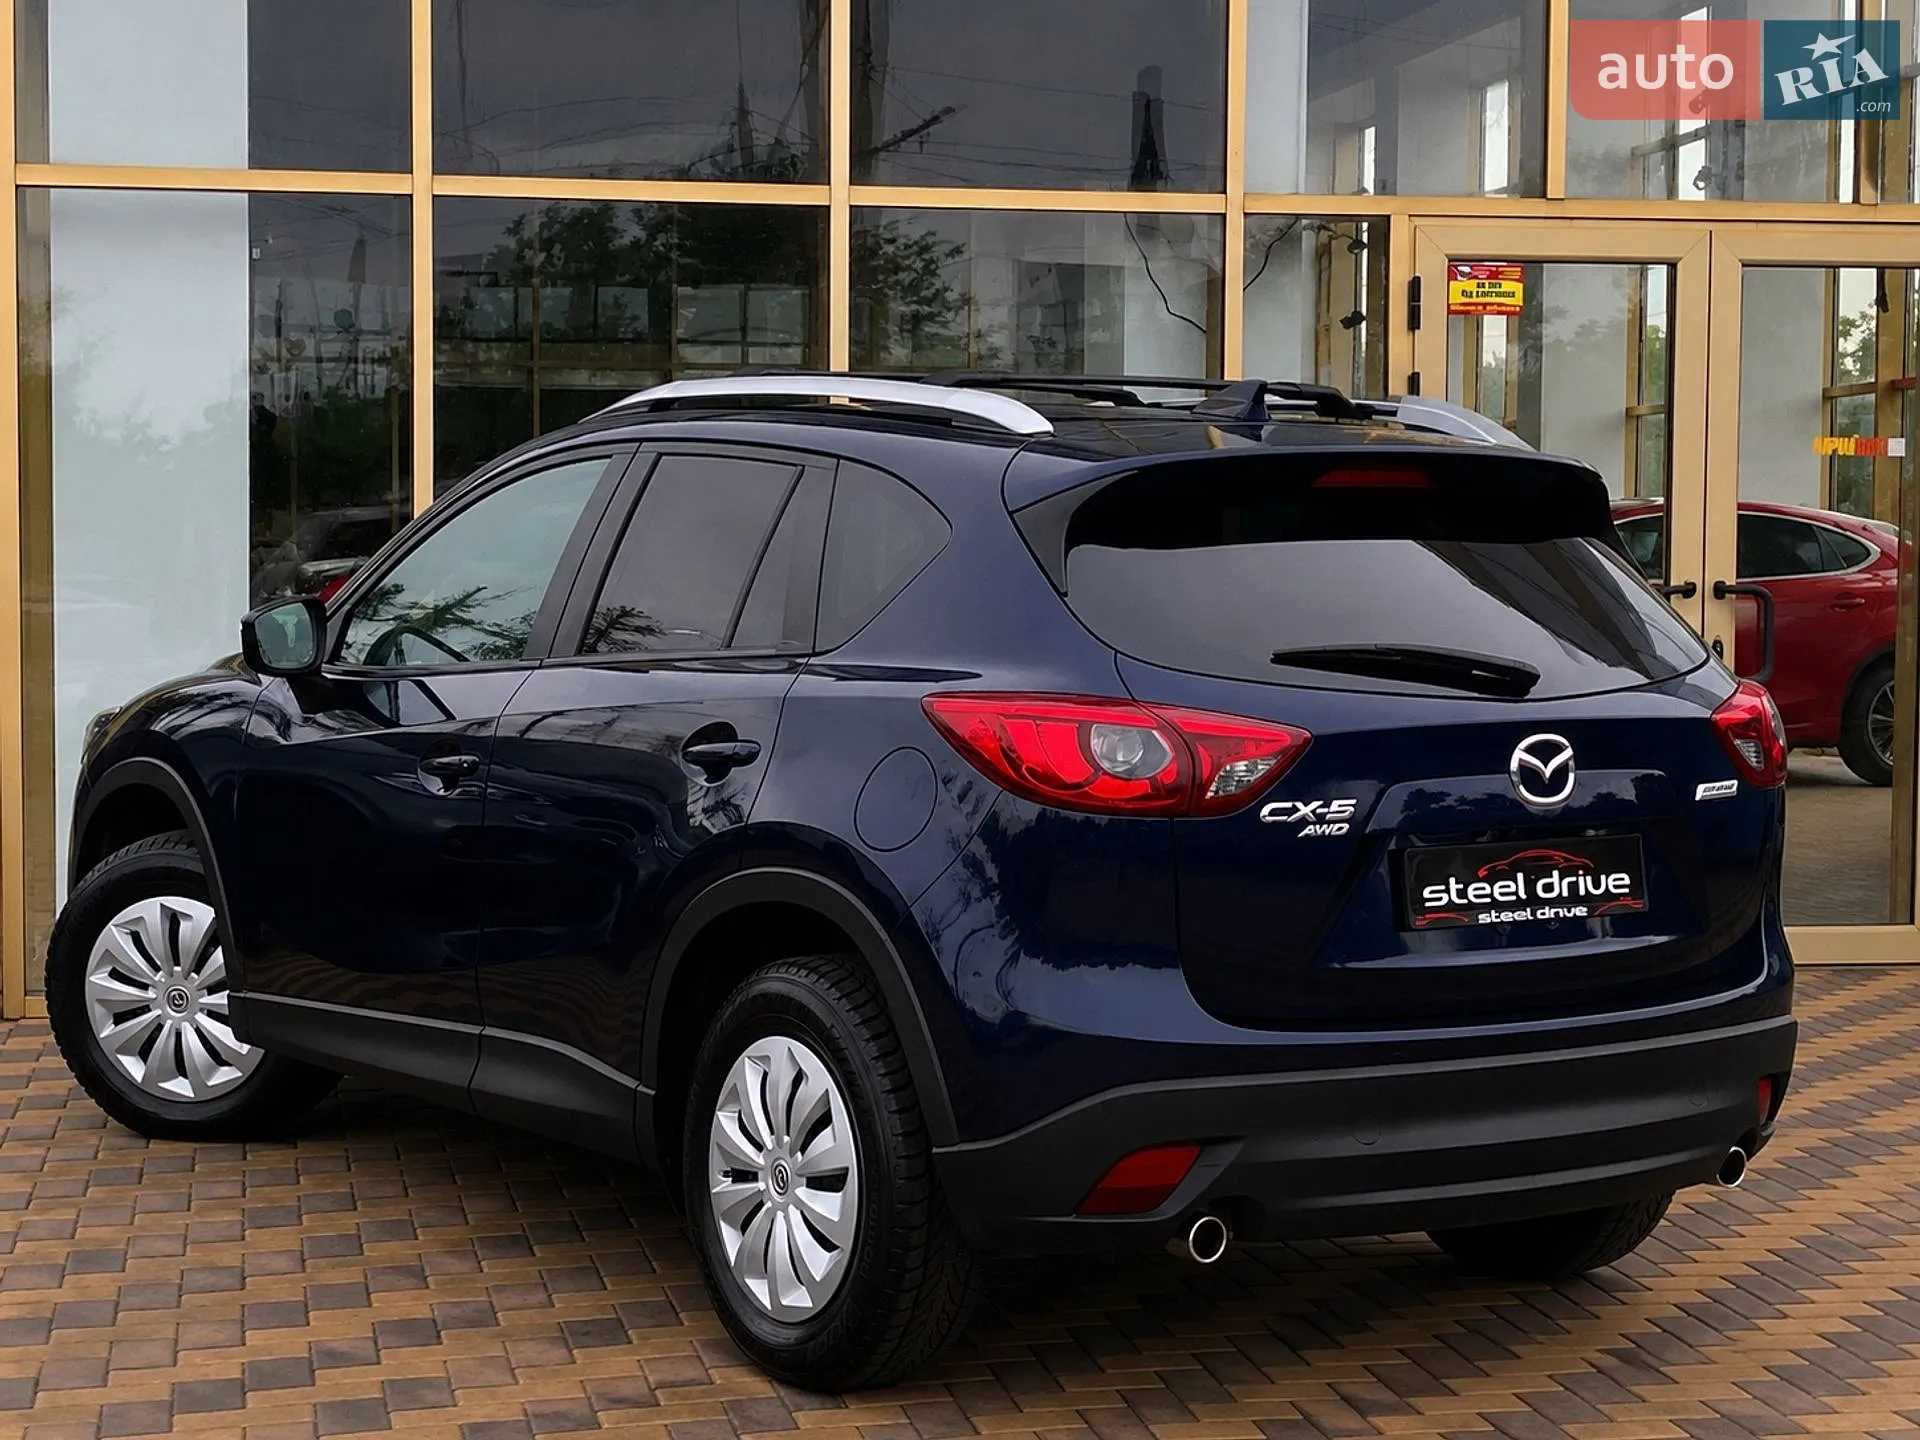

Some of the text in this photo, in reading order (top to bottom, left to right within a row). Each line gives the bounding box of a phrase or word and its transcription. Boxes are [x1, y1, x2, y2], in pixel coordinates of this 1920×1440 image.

[1259, 799, 1358, 823] CX-5
[1297, 823, 1350, 838] AWD
[1422, 869, 1632, 907] steel drive
[1477, 905, 1589, 924] steel drive
